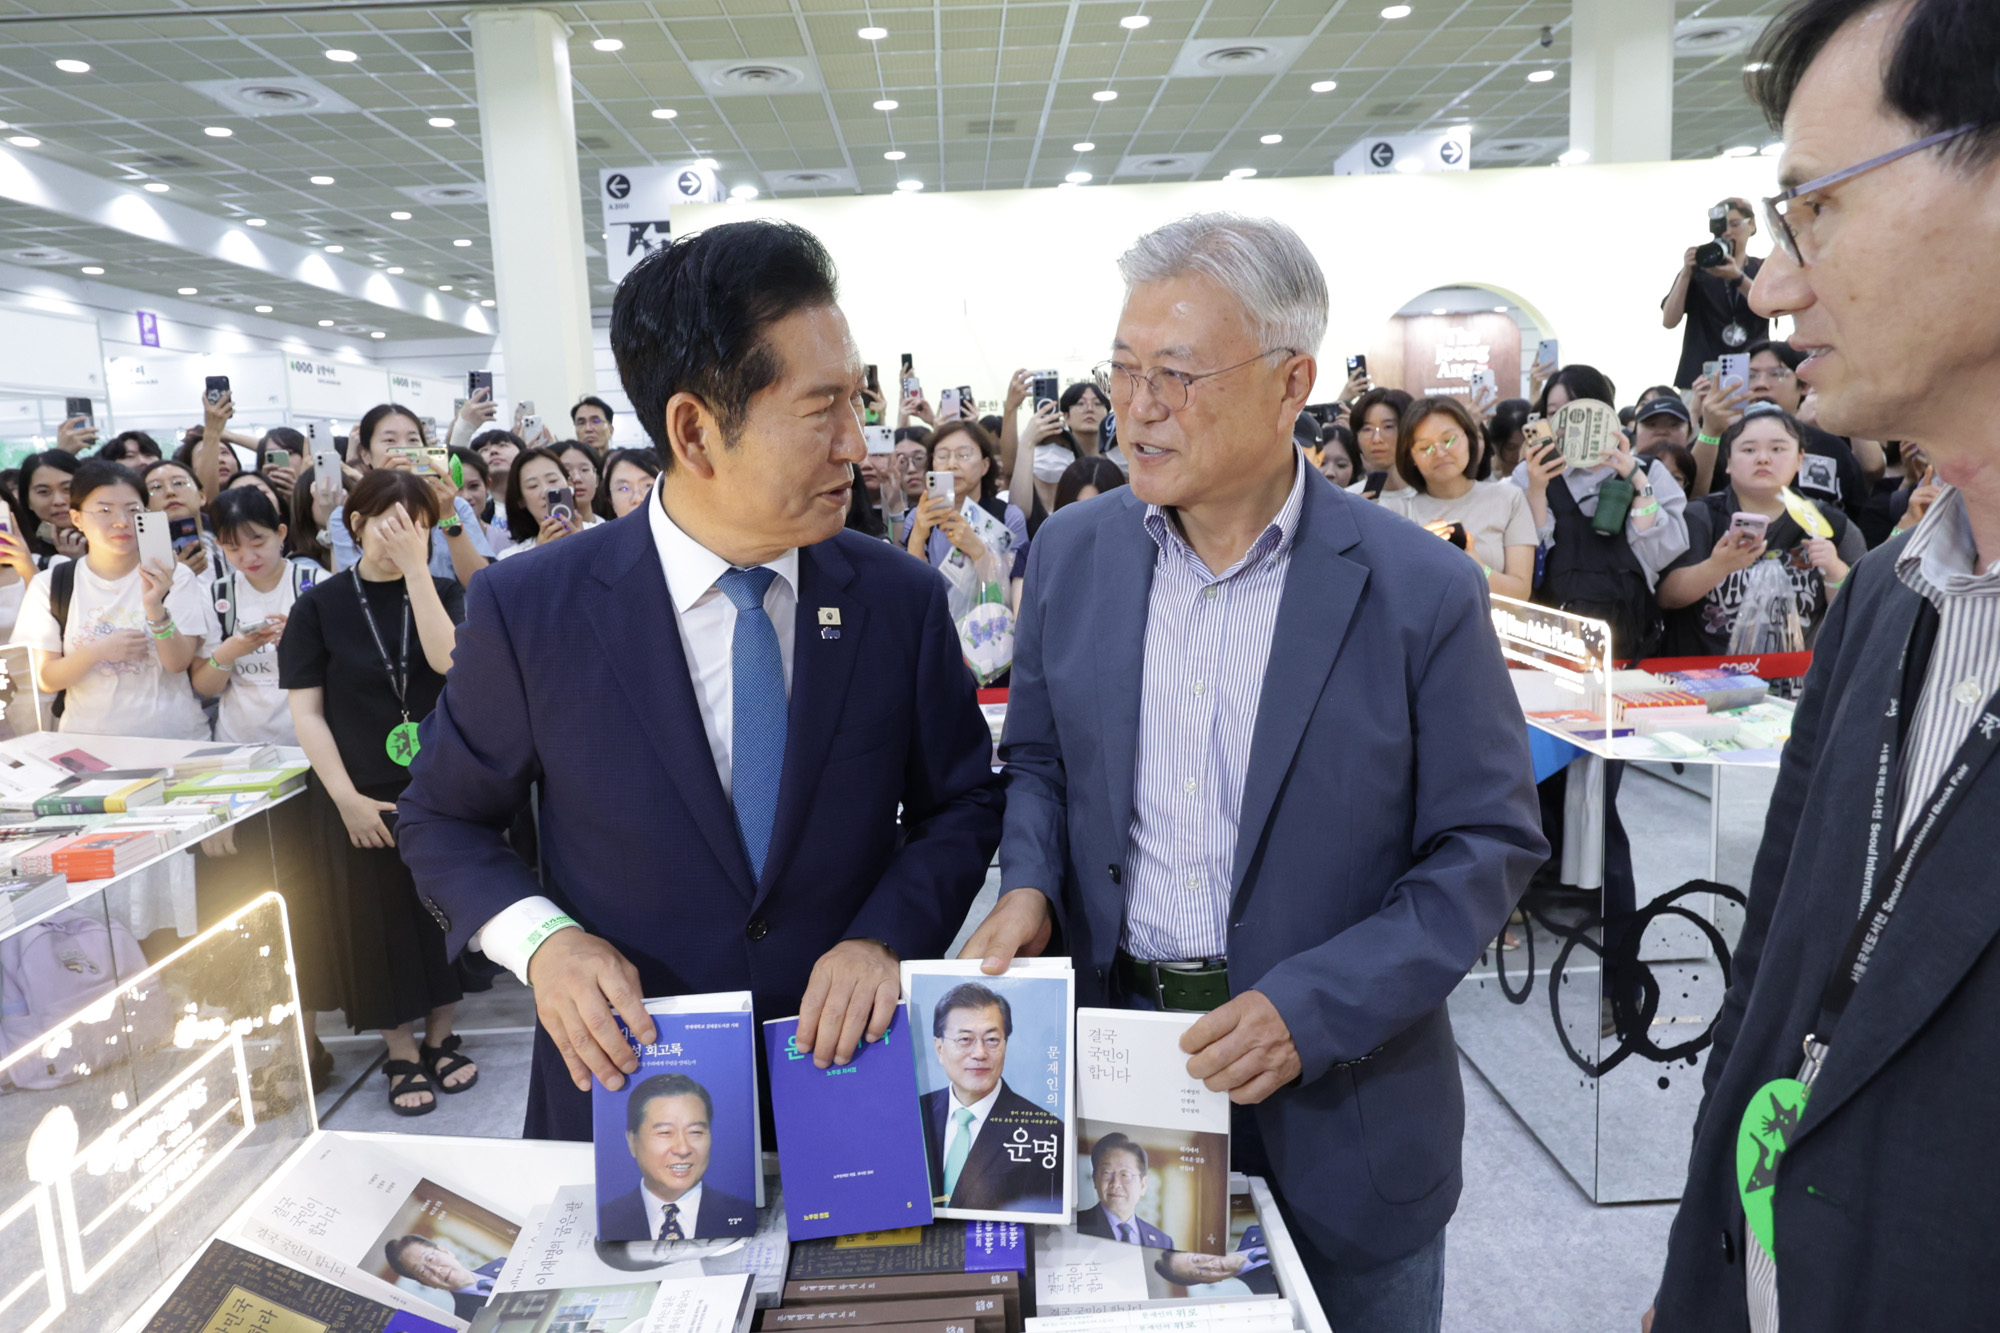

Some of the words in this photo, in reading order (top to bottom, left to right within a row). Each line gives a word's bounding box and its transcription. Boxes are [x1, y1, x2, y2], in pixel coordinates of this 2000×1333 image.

[1868, 823, 1882, 856] Seoul
[1882, 879, 1904, 913] Seoul
[1898, 813, 1937, 883] International
[1931, 786, 1955, 815] Book
[1949, 762, 1969, 786] Fair
[645, 1042, 684, 1058] 회고록
[1088, 1027, 1118, 1044] 결국
[1088, 1046, 1129, 1065] 국민이
[1046, 1045, 1060, 1107] 문재인의
[1088, 1064, 1132, 1083] 합니다
[1003, 1127, 1058, 1169] 운명
[272, 1197, 298, 1219] 결국
[289, 1197, 324, 1228] 국민이
[308, 1206, 342, 1237] 합니다
[565, 1201, 583, 1213] 팔
[554, 1214, 578, 1237] 굽은
[534, 1241, 566, 1285] 이재명의
[1066, 1263, 1083, 1294] 국민이
[1085, 1261, 1103, 1294] 합니다
[1048, 1272, 1064, 1295] 결국
